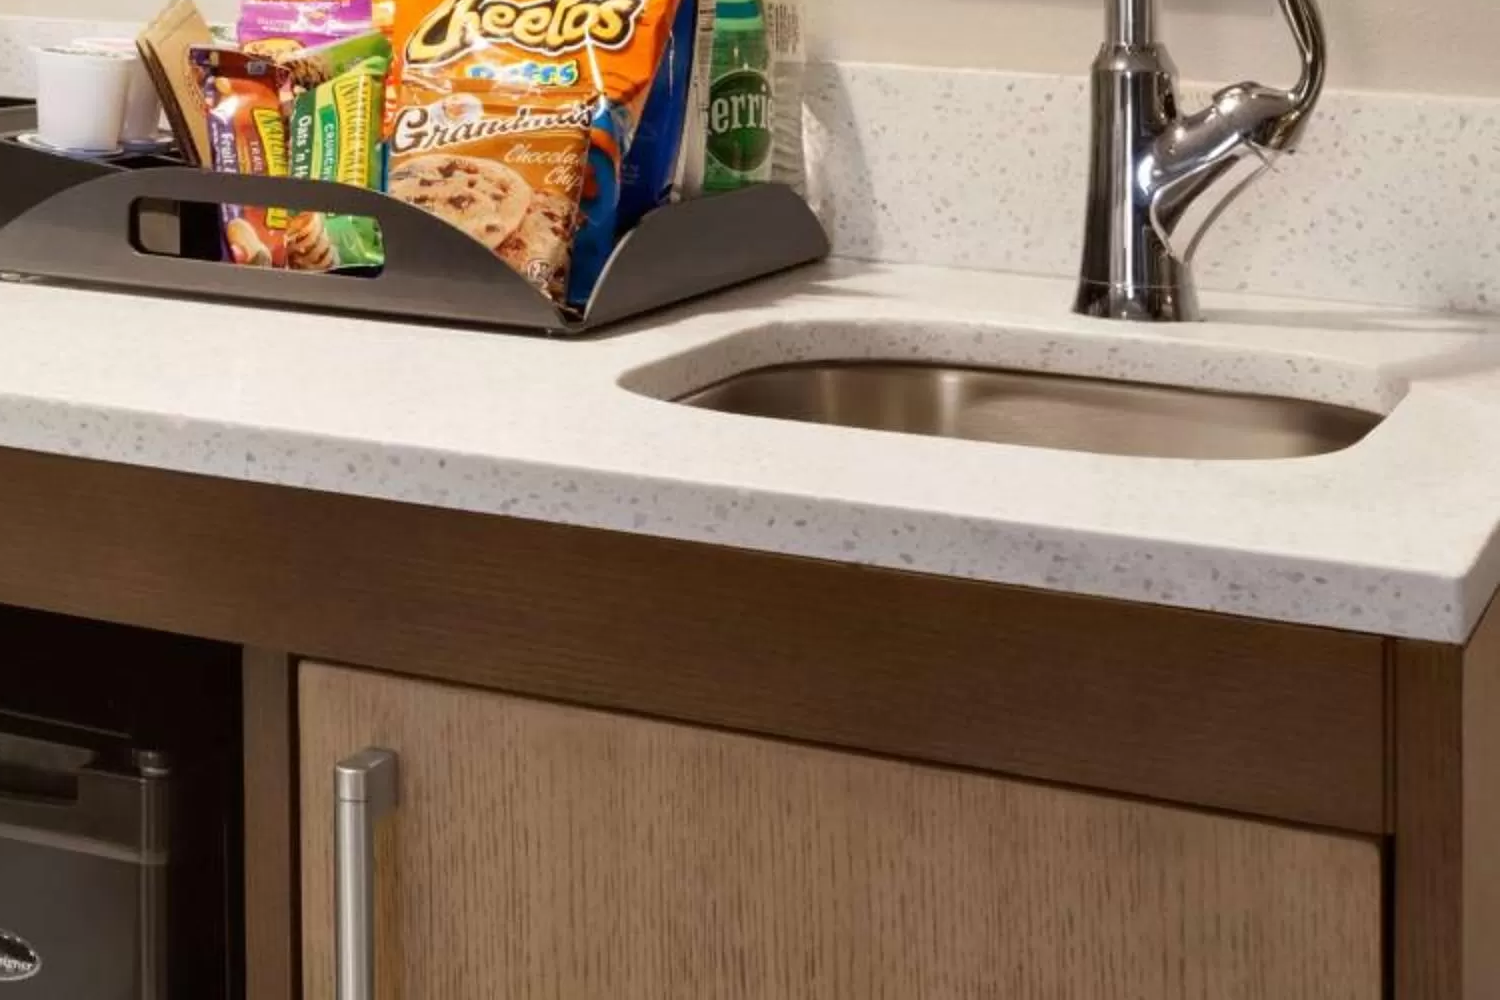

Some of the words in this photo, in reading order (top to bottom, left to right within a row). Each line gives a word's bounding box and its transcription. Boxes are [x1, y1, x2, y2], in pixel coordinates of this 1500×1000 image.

[296, 115, 312, 147] Oats
[391, 101, 593, 155] Grandma's
[705, 84, 775, 136] erri
[221, 133, 235, 167] Fruit
